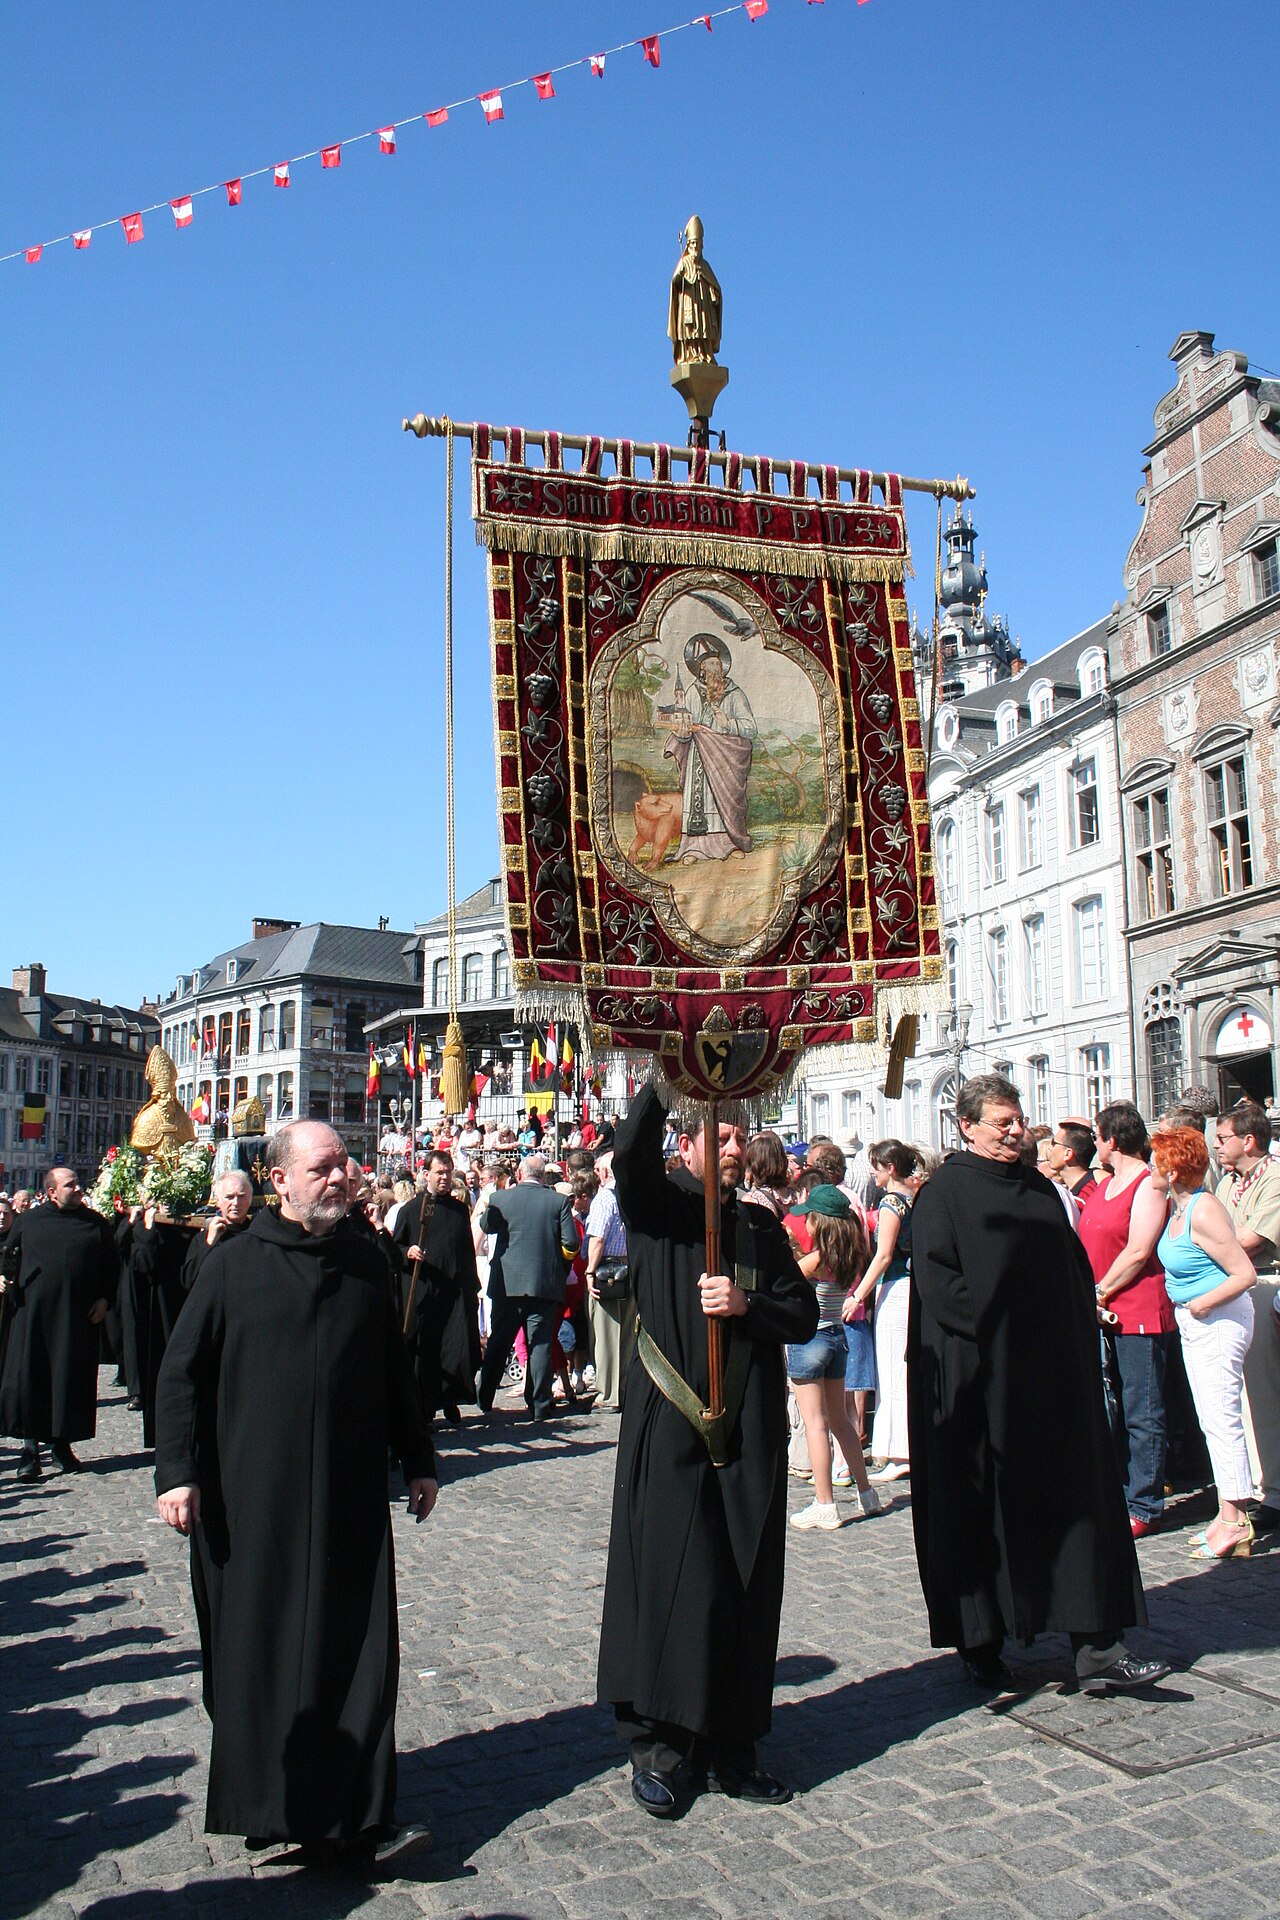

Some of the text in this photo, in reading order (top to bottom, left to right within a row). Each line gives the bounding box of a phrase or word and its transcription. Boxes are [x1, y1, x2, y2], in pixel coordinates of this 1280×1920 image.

[540, 482, 612, 517] Saint
[755, 505, 774, 536] P.
[791, 509, 812, 540] P.
